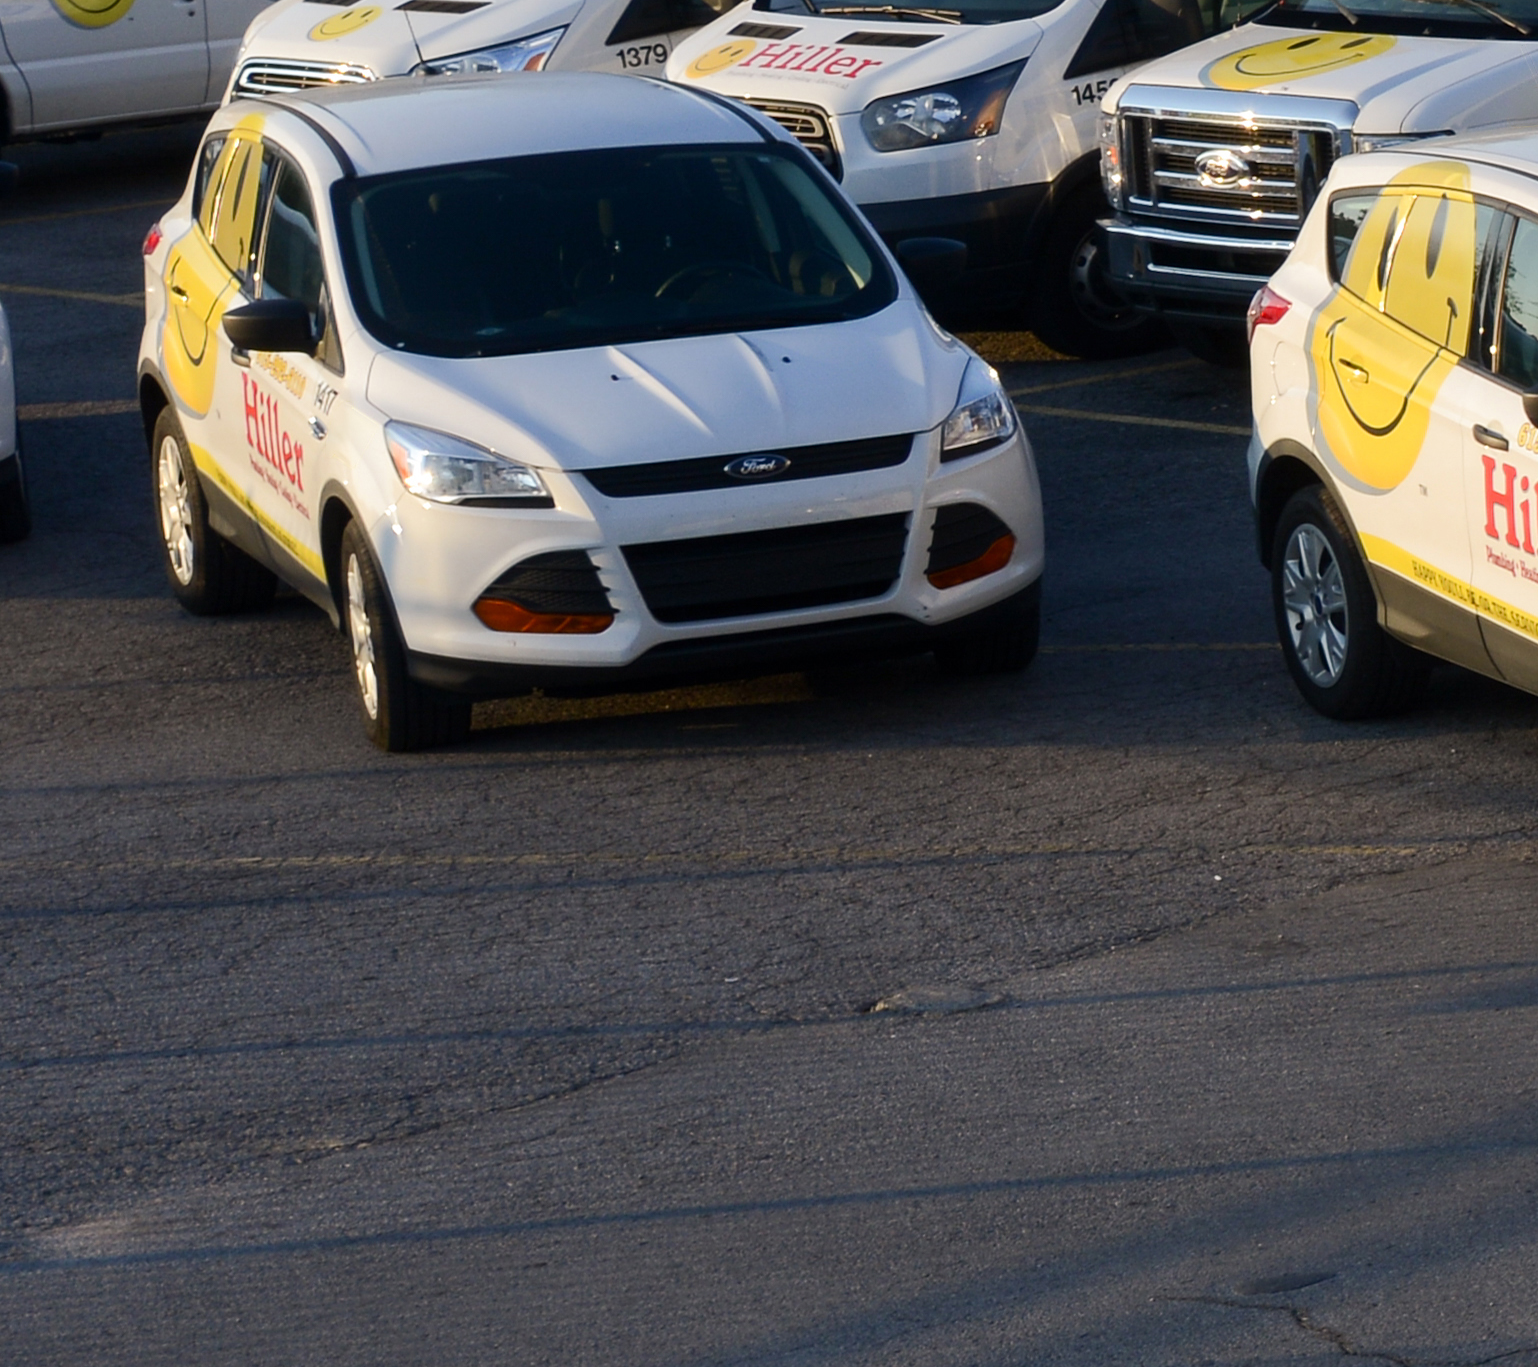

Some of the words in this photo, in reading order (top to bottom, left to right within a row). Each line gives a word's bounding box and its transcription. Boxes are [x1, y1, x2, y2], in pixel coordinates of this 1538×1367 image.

[617, 43, 668, 69] 1379
[740, 42, 881, 79] Hiller
[1071, 79, 1118, 106] 145
[241, 370, 304, 493] Hiller
[740, 458, 778, 474] Ford
